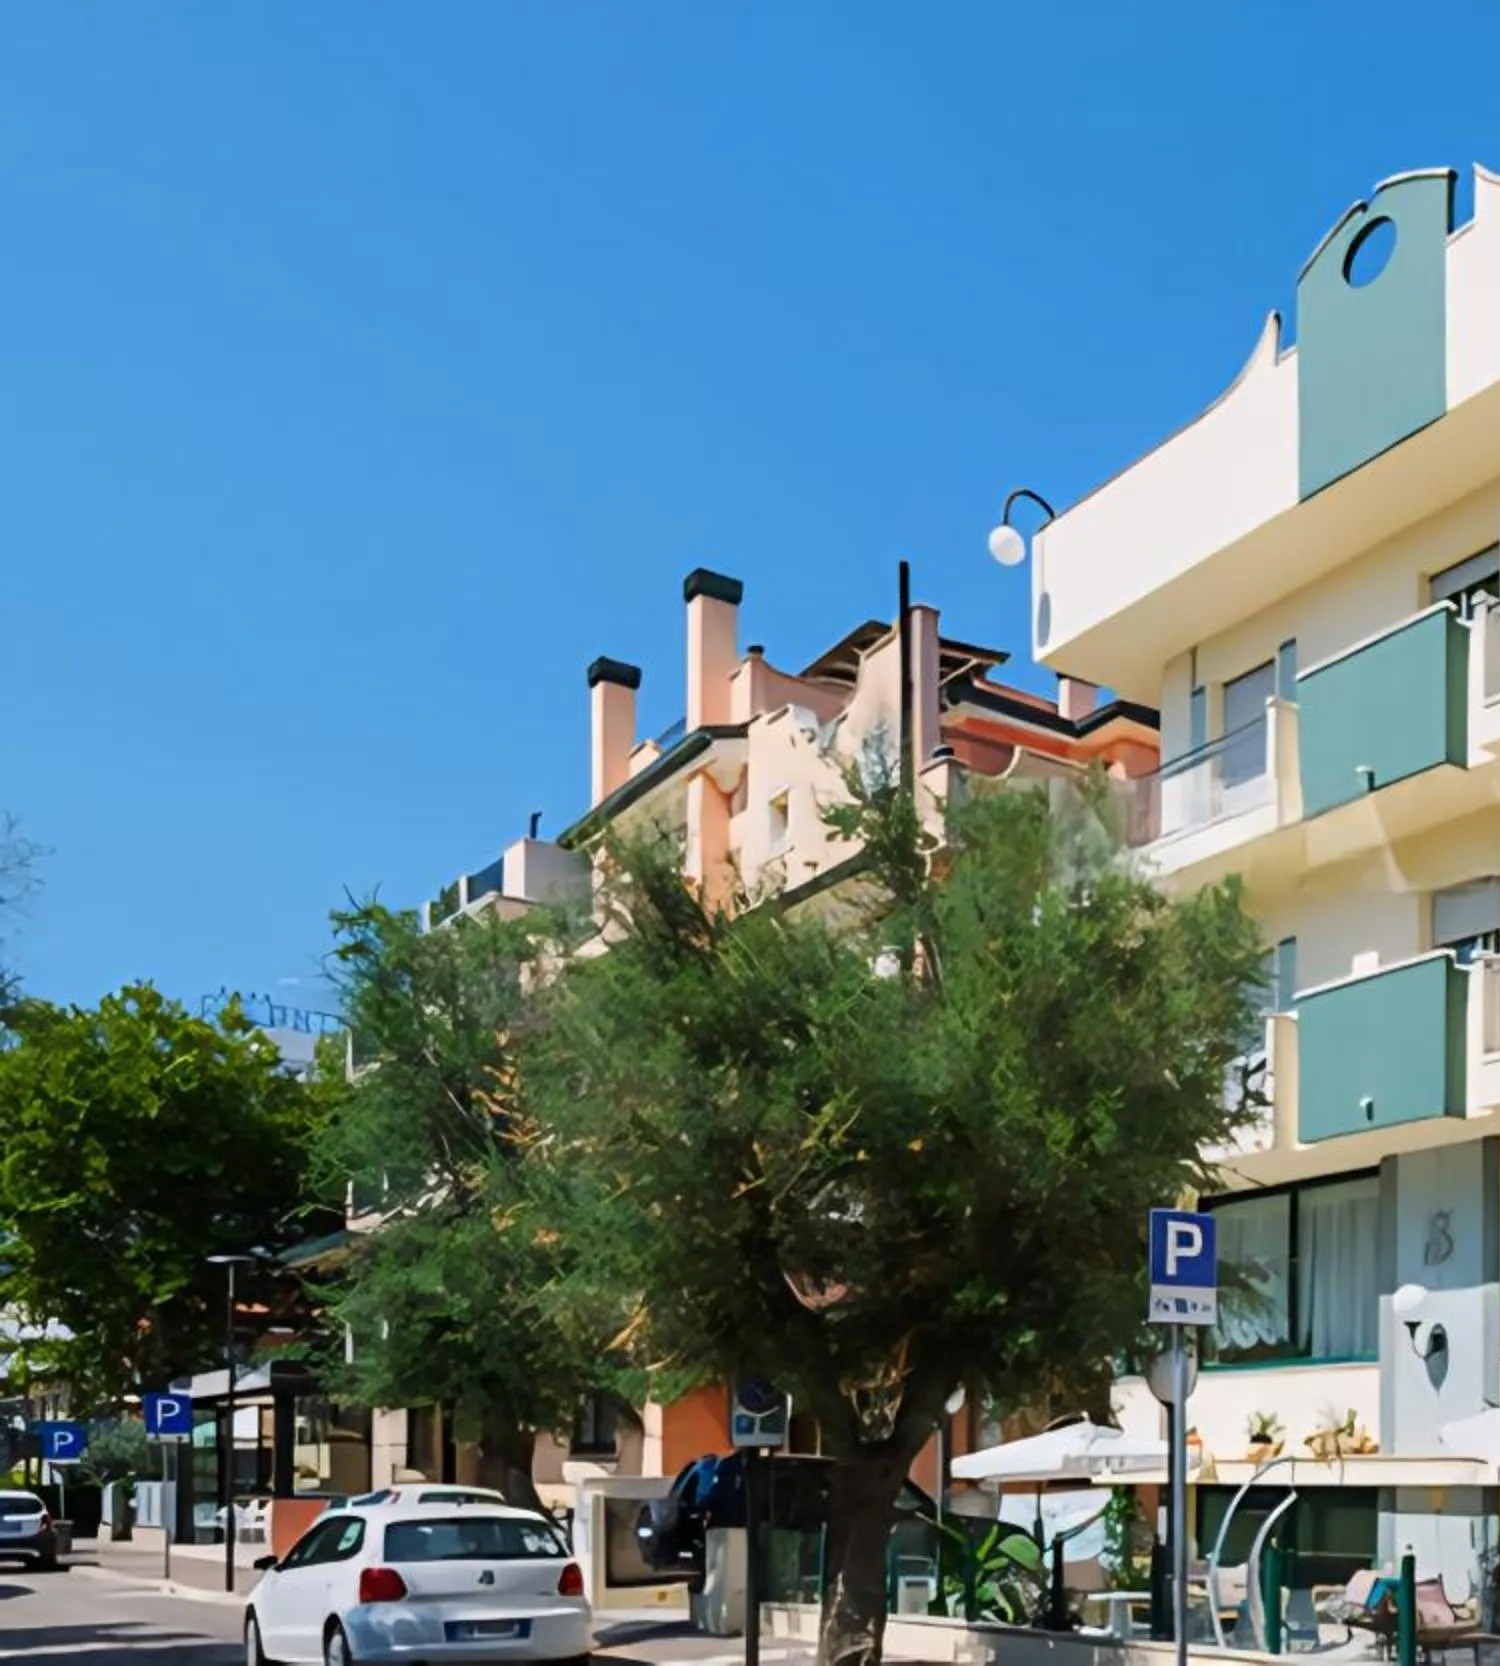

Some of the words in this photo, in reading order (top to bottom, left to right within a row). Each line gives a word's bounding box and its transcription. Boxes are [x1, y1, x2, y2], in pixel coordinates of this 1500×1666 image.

[1165, 1220, 1203, 1276] P
[156, 1398, 181, 1429] P
[53, 1431, 74, 1454] P
